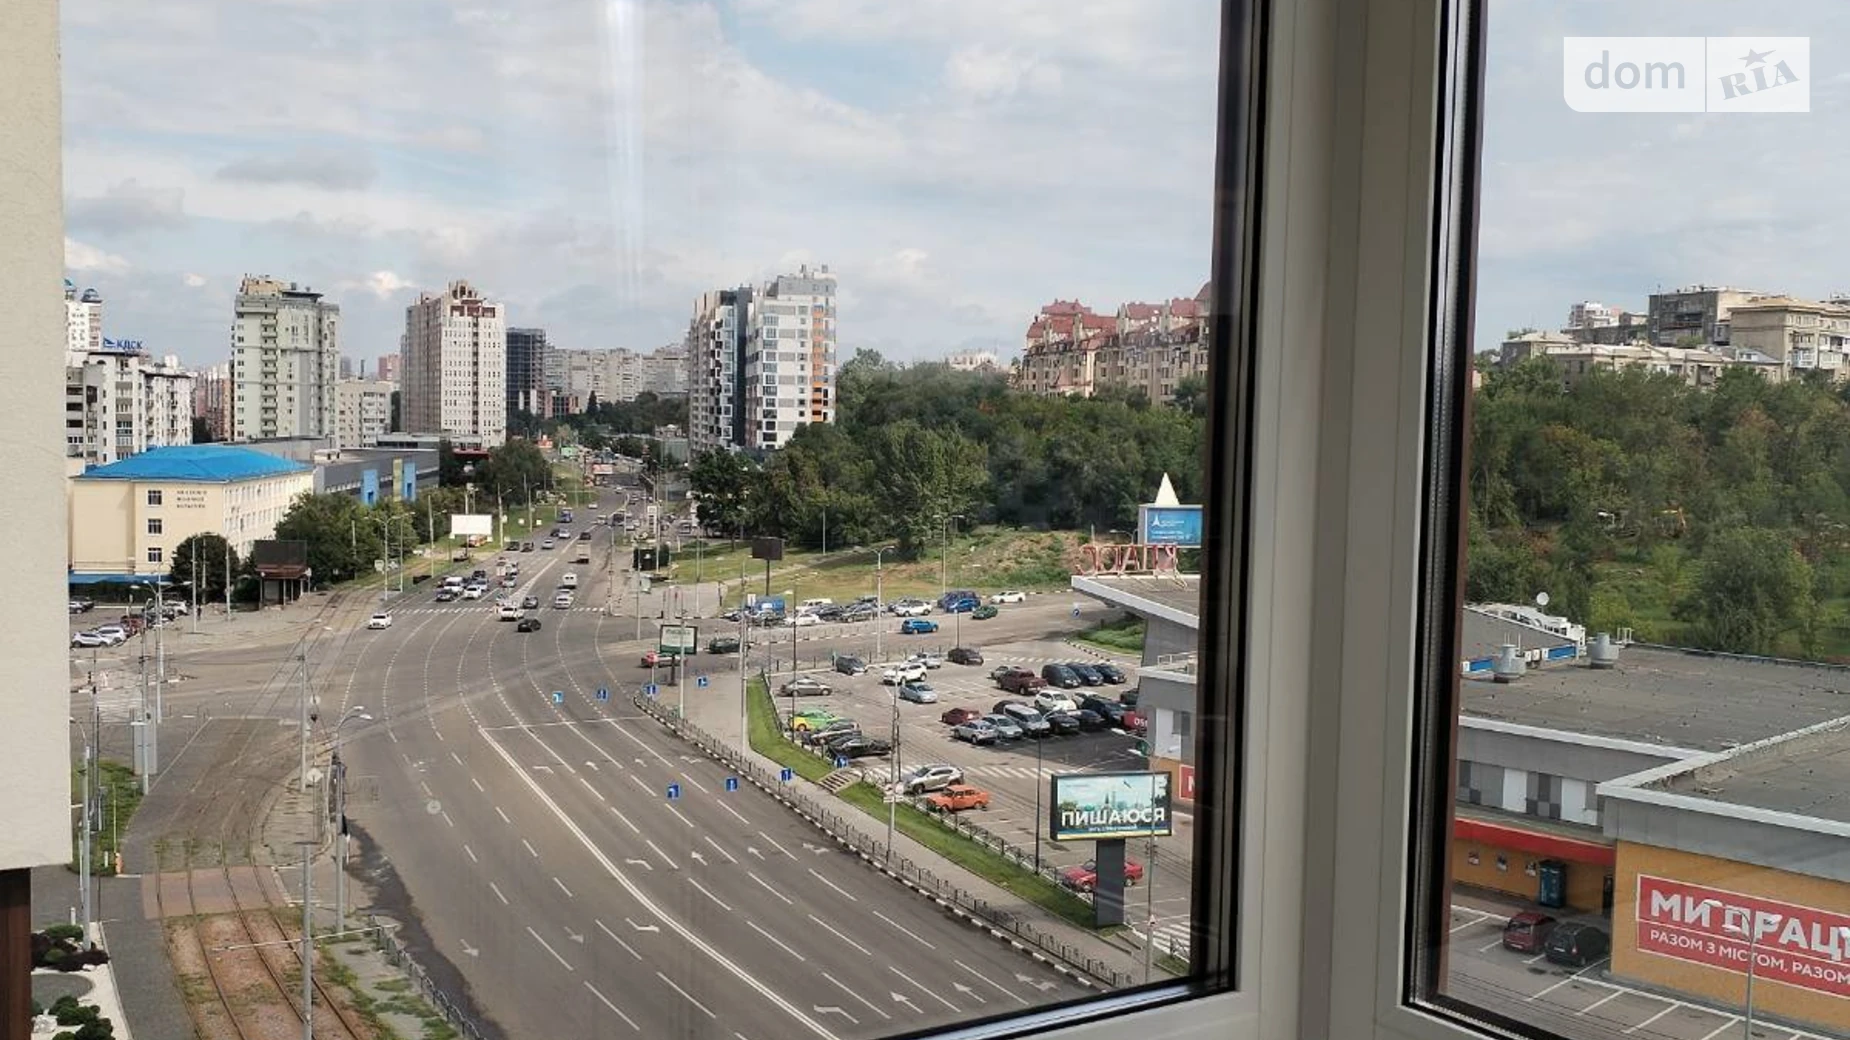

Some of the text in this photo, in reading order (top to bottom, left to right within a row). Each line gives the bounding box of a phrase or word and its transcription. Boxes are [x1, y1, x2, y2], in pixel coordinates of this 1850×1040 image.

[1061, 807, 1165, 827] ПИШАЮСЯ
[1651, 889, 1711, 928] МИ
[1650, 929, 1703, 954] РАЗОМ
